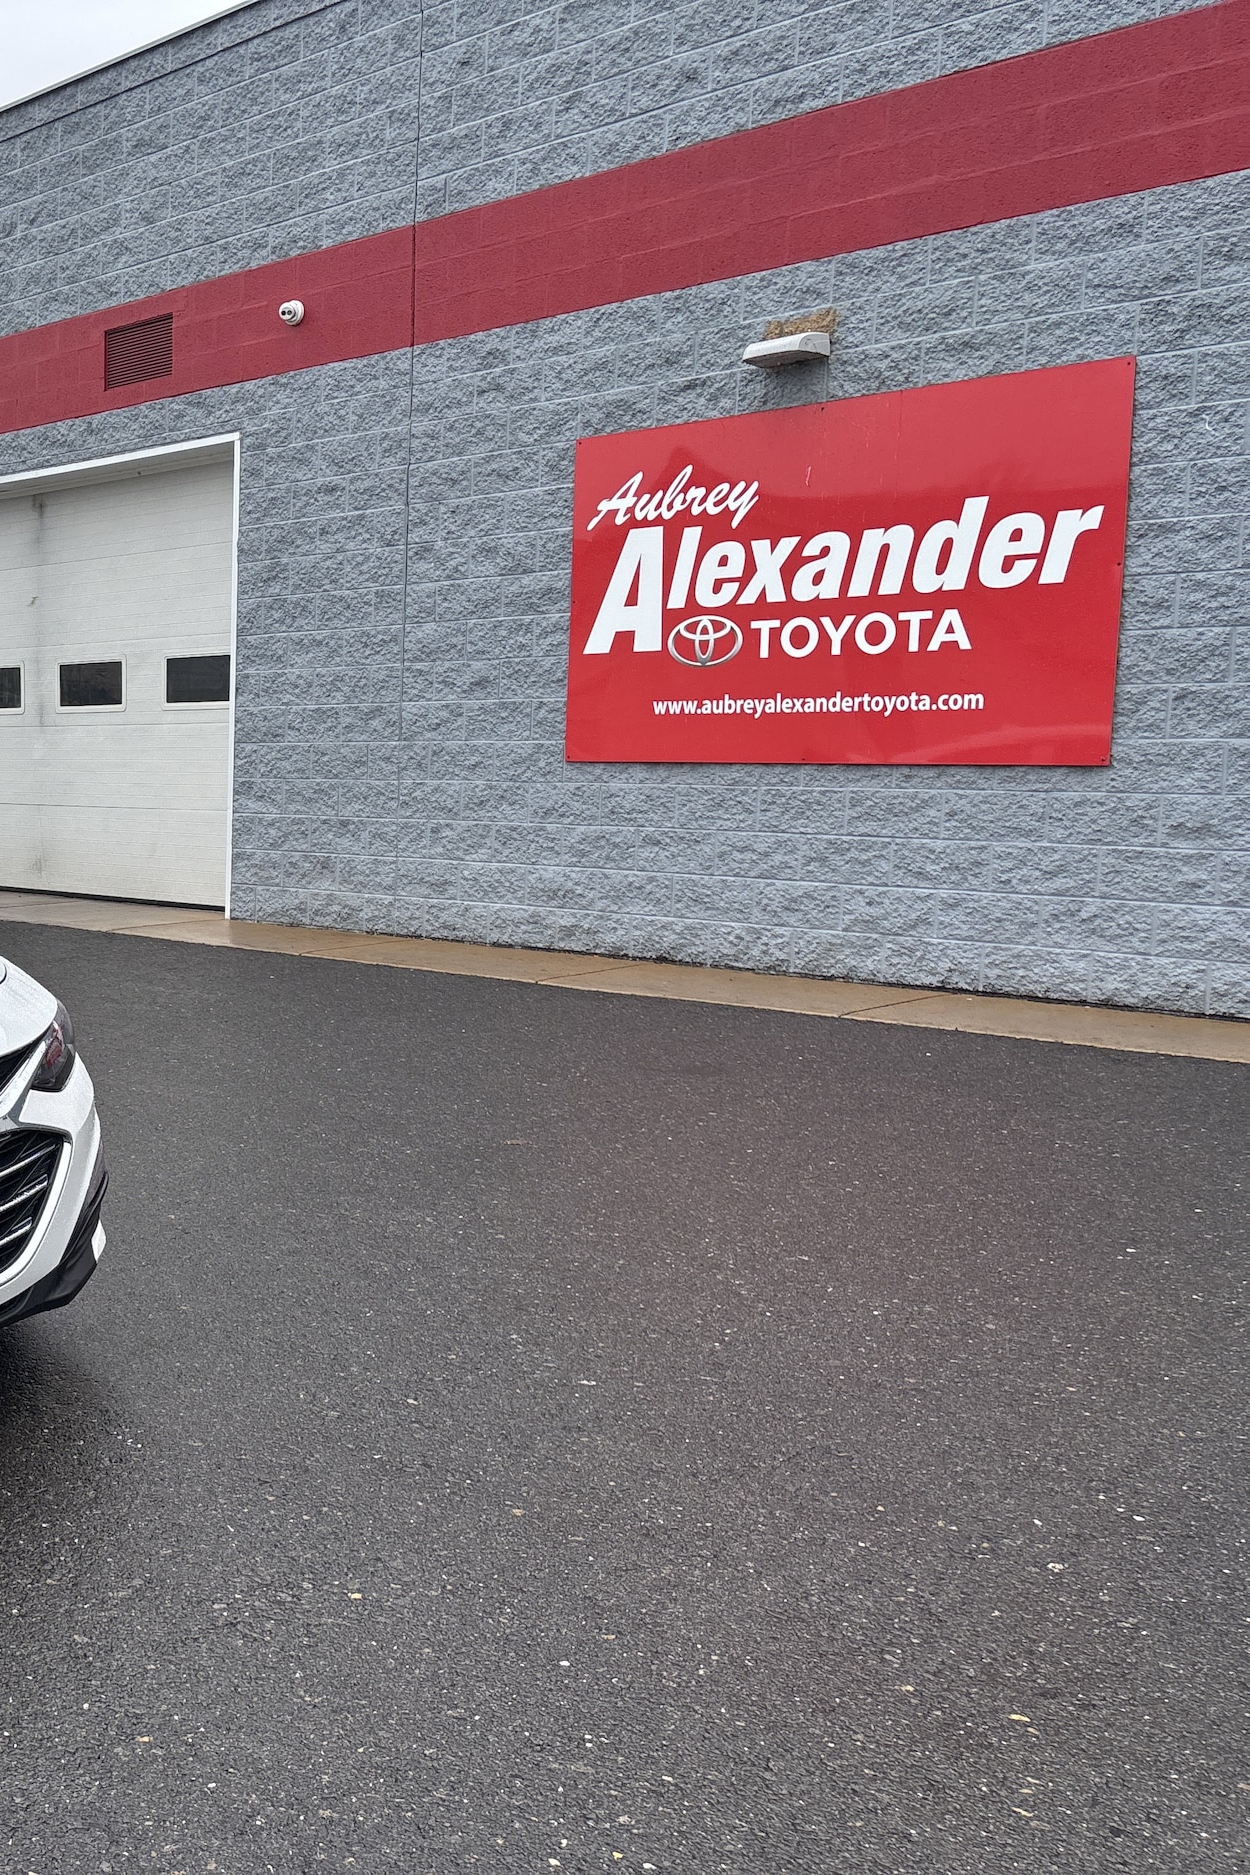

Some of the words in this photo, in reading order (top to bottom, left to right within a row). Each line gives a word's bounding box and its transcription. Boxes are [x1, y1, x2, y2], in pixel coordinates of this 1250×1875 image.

[587, 465, 759, 531] Aubrey
[583, 496, 1104, 655] Alexander
[751, 609, 972, 659] TOYOTA
[653, 692, 985, 718] www.aubreyalexandertoyota.com
